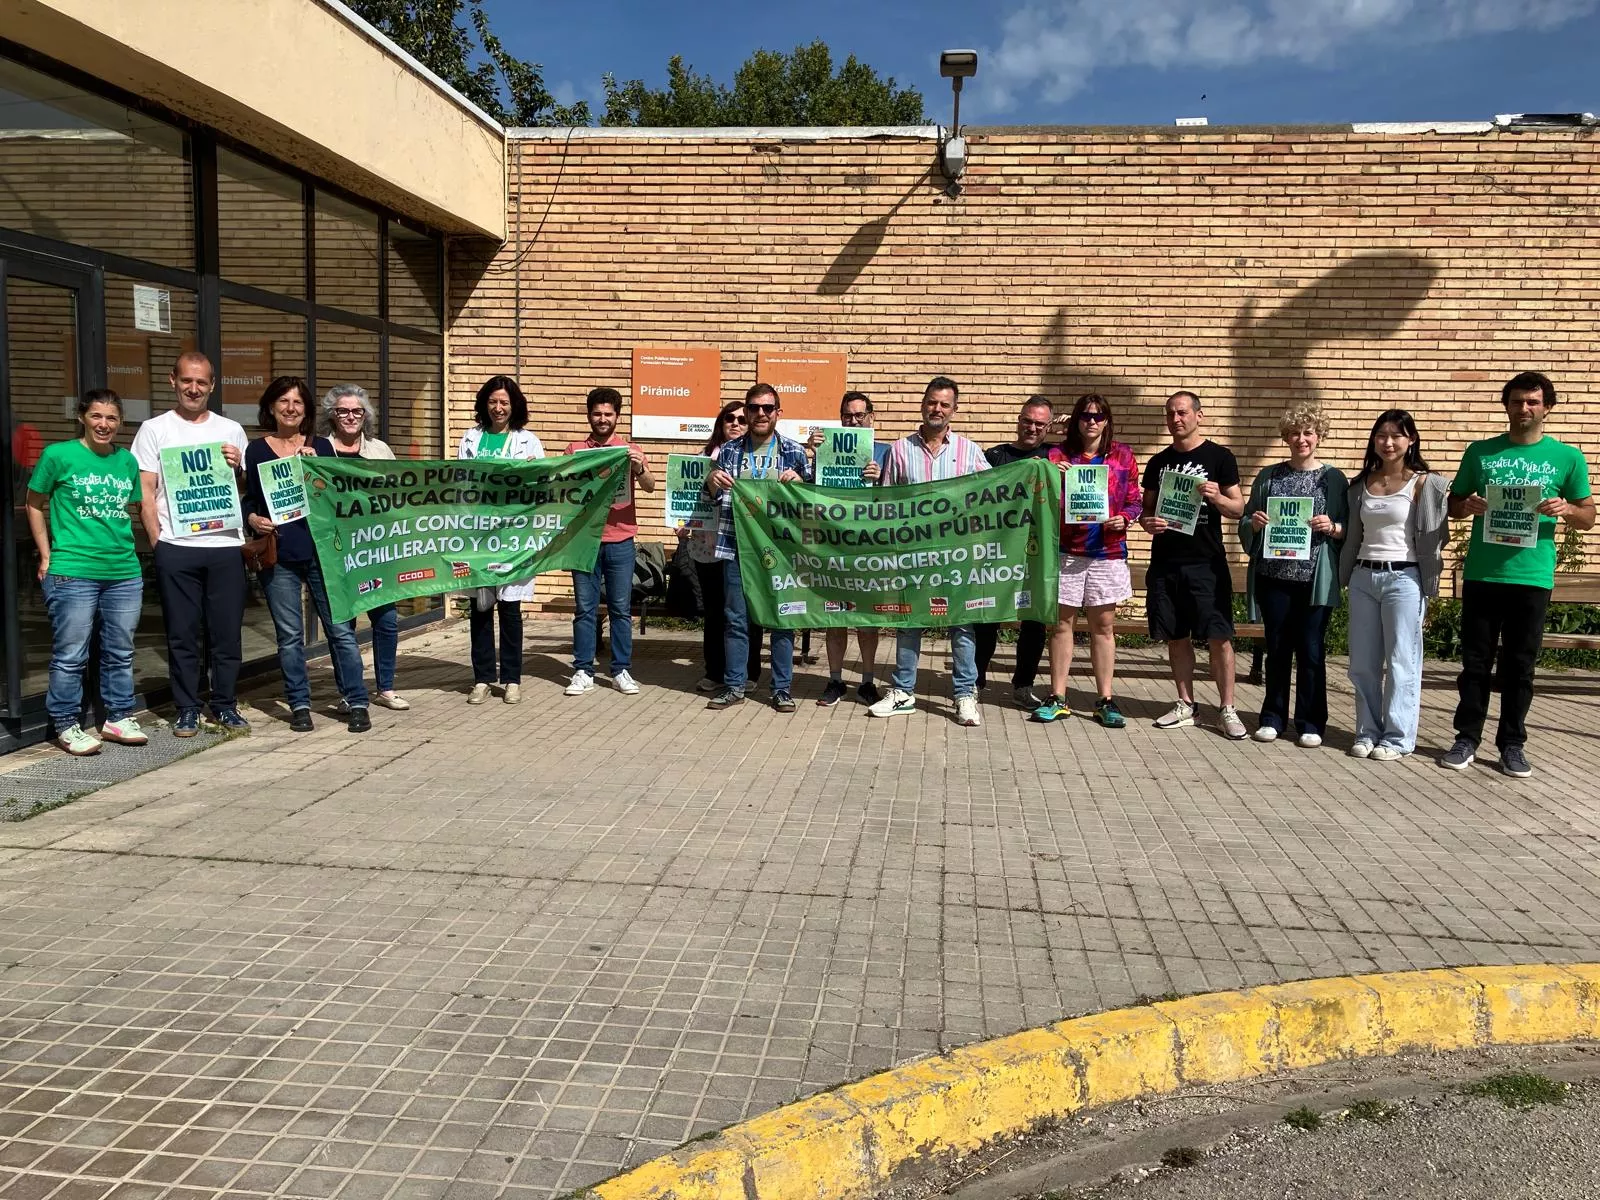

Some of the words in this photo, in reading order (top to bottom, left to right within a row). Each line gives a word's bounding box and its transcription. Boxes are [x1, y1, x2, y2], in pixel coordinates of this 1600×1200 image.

[640, 385, 691, 397] Pirámide
[833, 432, 858, 454] NO!
[181, 448, 213, 473] NO!
[835, 455, 841, 466] A
[841, 456, 856, 466] LOS
[1481, 457, 1519, 470] ESCUELA
[271, 461, 293, 480] NO!
[681, 460, 704, 479] NO!
[822, 466, 864, 477] CONCIERTO
[1078, 468, 1097, 484] NO!
[189, 475, 196, 487] A
[196, 473, 215, 486] LOS
[277, 482, 283, 490] A
[283, 479, 295, 489] LOS
[332, 470, 418, 493] DINERO
[683, 481, 689, 490] A
[689, 481, 703, 490] LOS
[1174, 476, 1194, 494] NO!
[1489, 478, 1503, 486] DE
[175, 485, 233, 502] CONCIERTOS
[270, 485, 304, 501] CONCIERTOS
[671, 490, 702, 501] CONCIER
[1070, 493, 1104, 501] CONCIERTOS
[1172, 492, 1178, 500] A
[1178, 493, 1190, 502] LOS
[1503, 488, 1526, 500] NO!
[177, 497, 234, 514] EDUCATIVOS
[273, 494, 305, 510] EDUCATIVOS
[336, 500, 364, 518] LA
[368, 484, 498, 515] EDUCACIÓN
[505, 484, 596, 506] PÚBLICA
[671, 501, 713, 512] EDUCATIVOS
[766, 500, 847, 521] DINERO
[853, 498, 958, 521] PÚBLICO,
[965, 482, 1029, 509] PARA
[1070, 501, 1104, 510] EDUCATIVOS
[1162, 497, 1196, 512] CONCIERTOS
[1503, 502, 1509, 510] A
[1510, 502, 1524, 511] LOS
[1160, 505, 1195, 520] EDUCATIVOS
[1280, 501, 1300, 517] NO!
[1491, 510, 1535, 522] CONCIERTOS
[771, 525, 796, 544] LA
[801, 521, 932, 546] EDUCACIÓN
[939, 508, 1036, 538] PÚBLICA
[1280, 518, 1286, 526] A
[1286, 518, 1298, 527] LOS
[1490, 519, 1532, 530] EDUCATIVOS
[351, 524, 386, 549] ¡NO
[389, 520, 411, 538] AL
[415, 514, 528, 532] CONCIERTO
[532, 514, 565, 530] DEL
[1270, 526, 1308, 536] CONCIERTOS
[468, 536, 483, 552] Y
[487, 536, 520, 552] 0-3
[1270, 535, 1306, 544] EDUCATIVOS
[791, 552, 823, 571] ¡NO
[827, 556, 850, 571] AL
[853, 547, 968, 572] CONCIERTO
[973, 542, 1007, 561] DEL
[399, 570, 424, 582] CCOO
[771, 572, 907, 591] BACHILLERATO
[910, 574, 924, 590] Y
[929, 569, 963, 587] 0-3
[967, 562, 1030, 585] AÑOS!
[874, 604, 900, 612] CCOO
